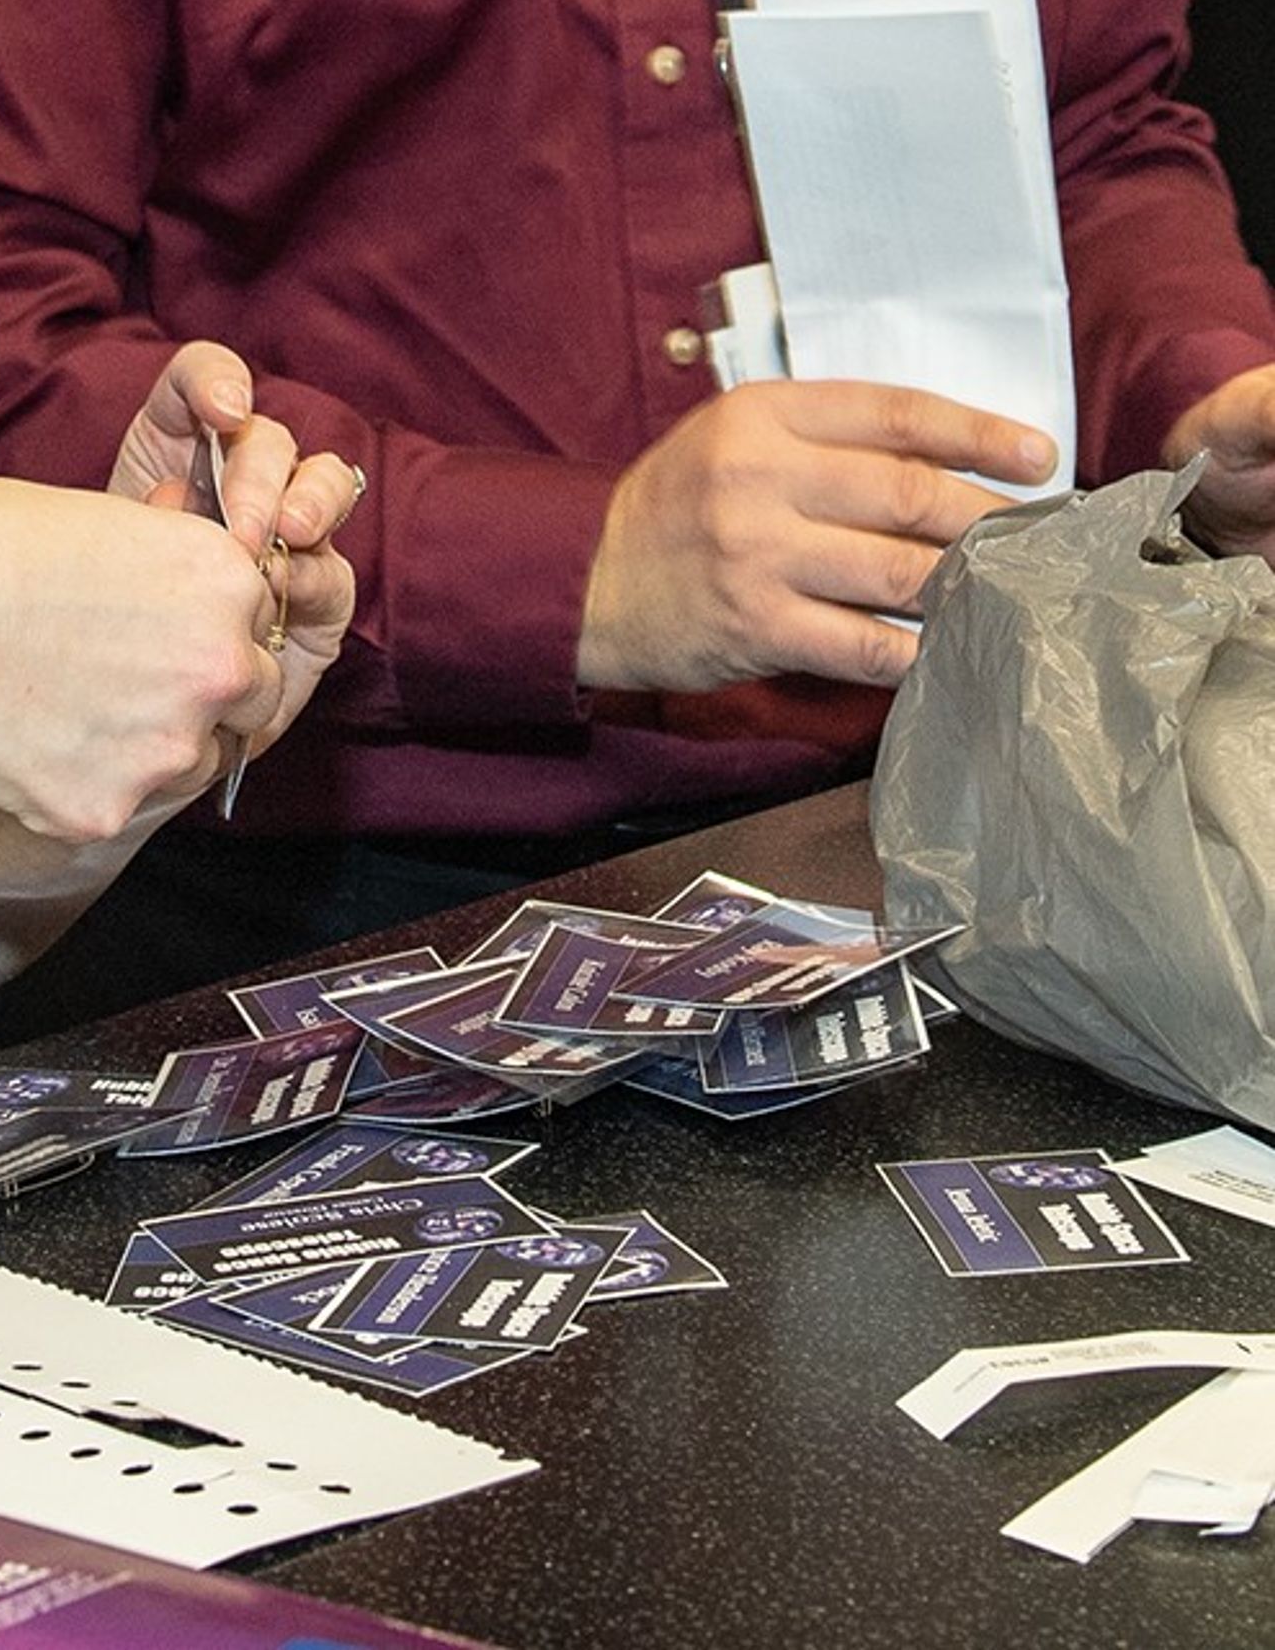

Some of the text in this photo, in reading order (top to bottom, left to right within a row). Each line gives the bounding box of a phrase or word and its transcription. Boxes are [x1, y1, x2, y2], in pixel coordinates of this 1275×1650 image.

[348, 1198, 423, 1216] Chris
[212, 1236, 402, 1273] Hubble Space
[220, 1229, 363, 1258] Telescope
